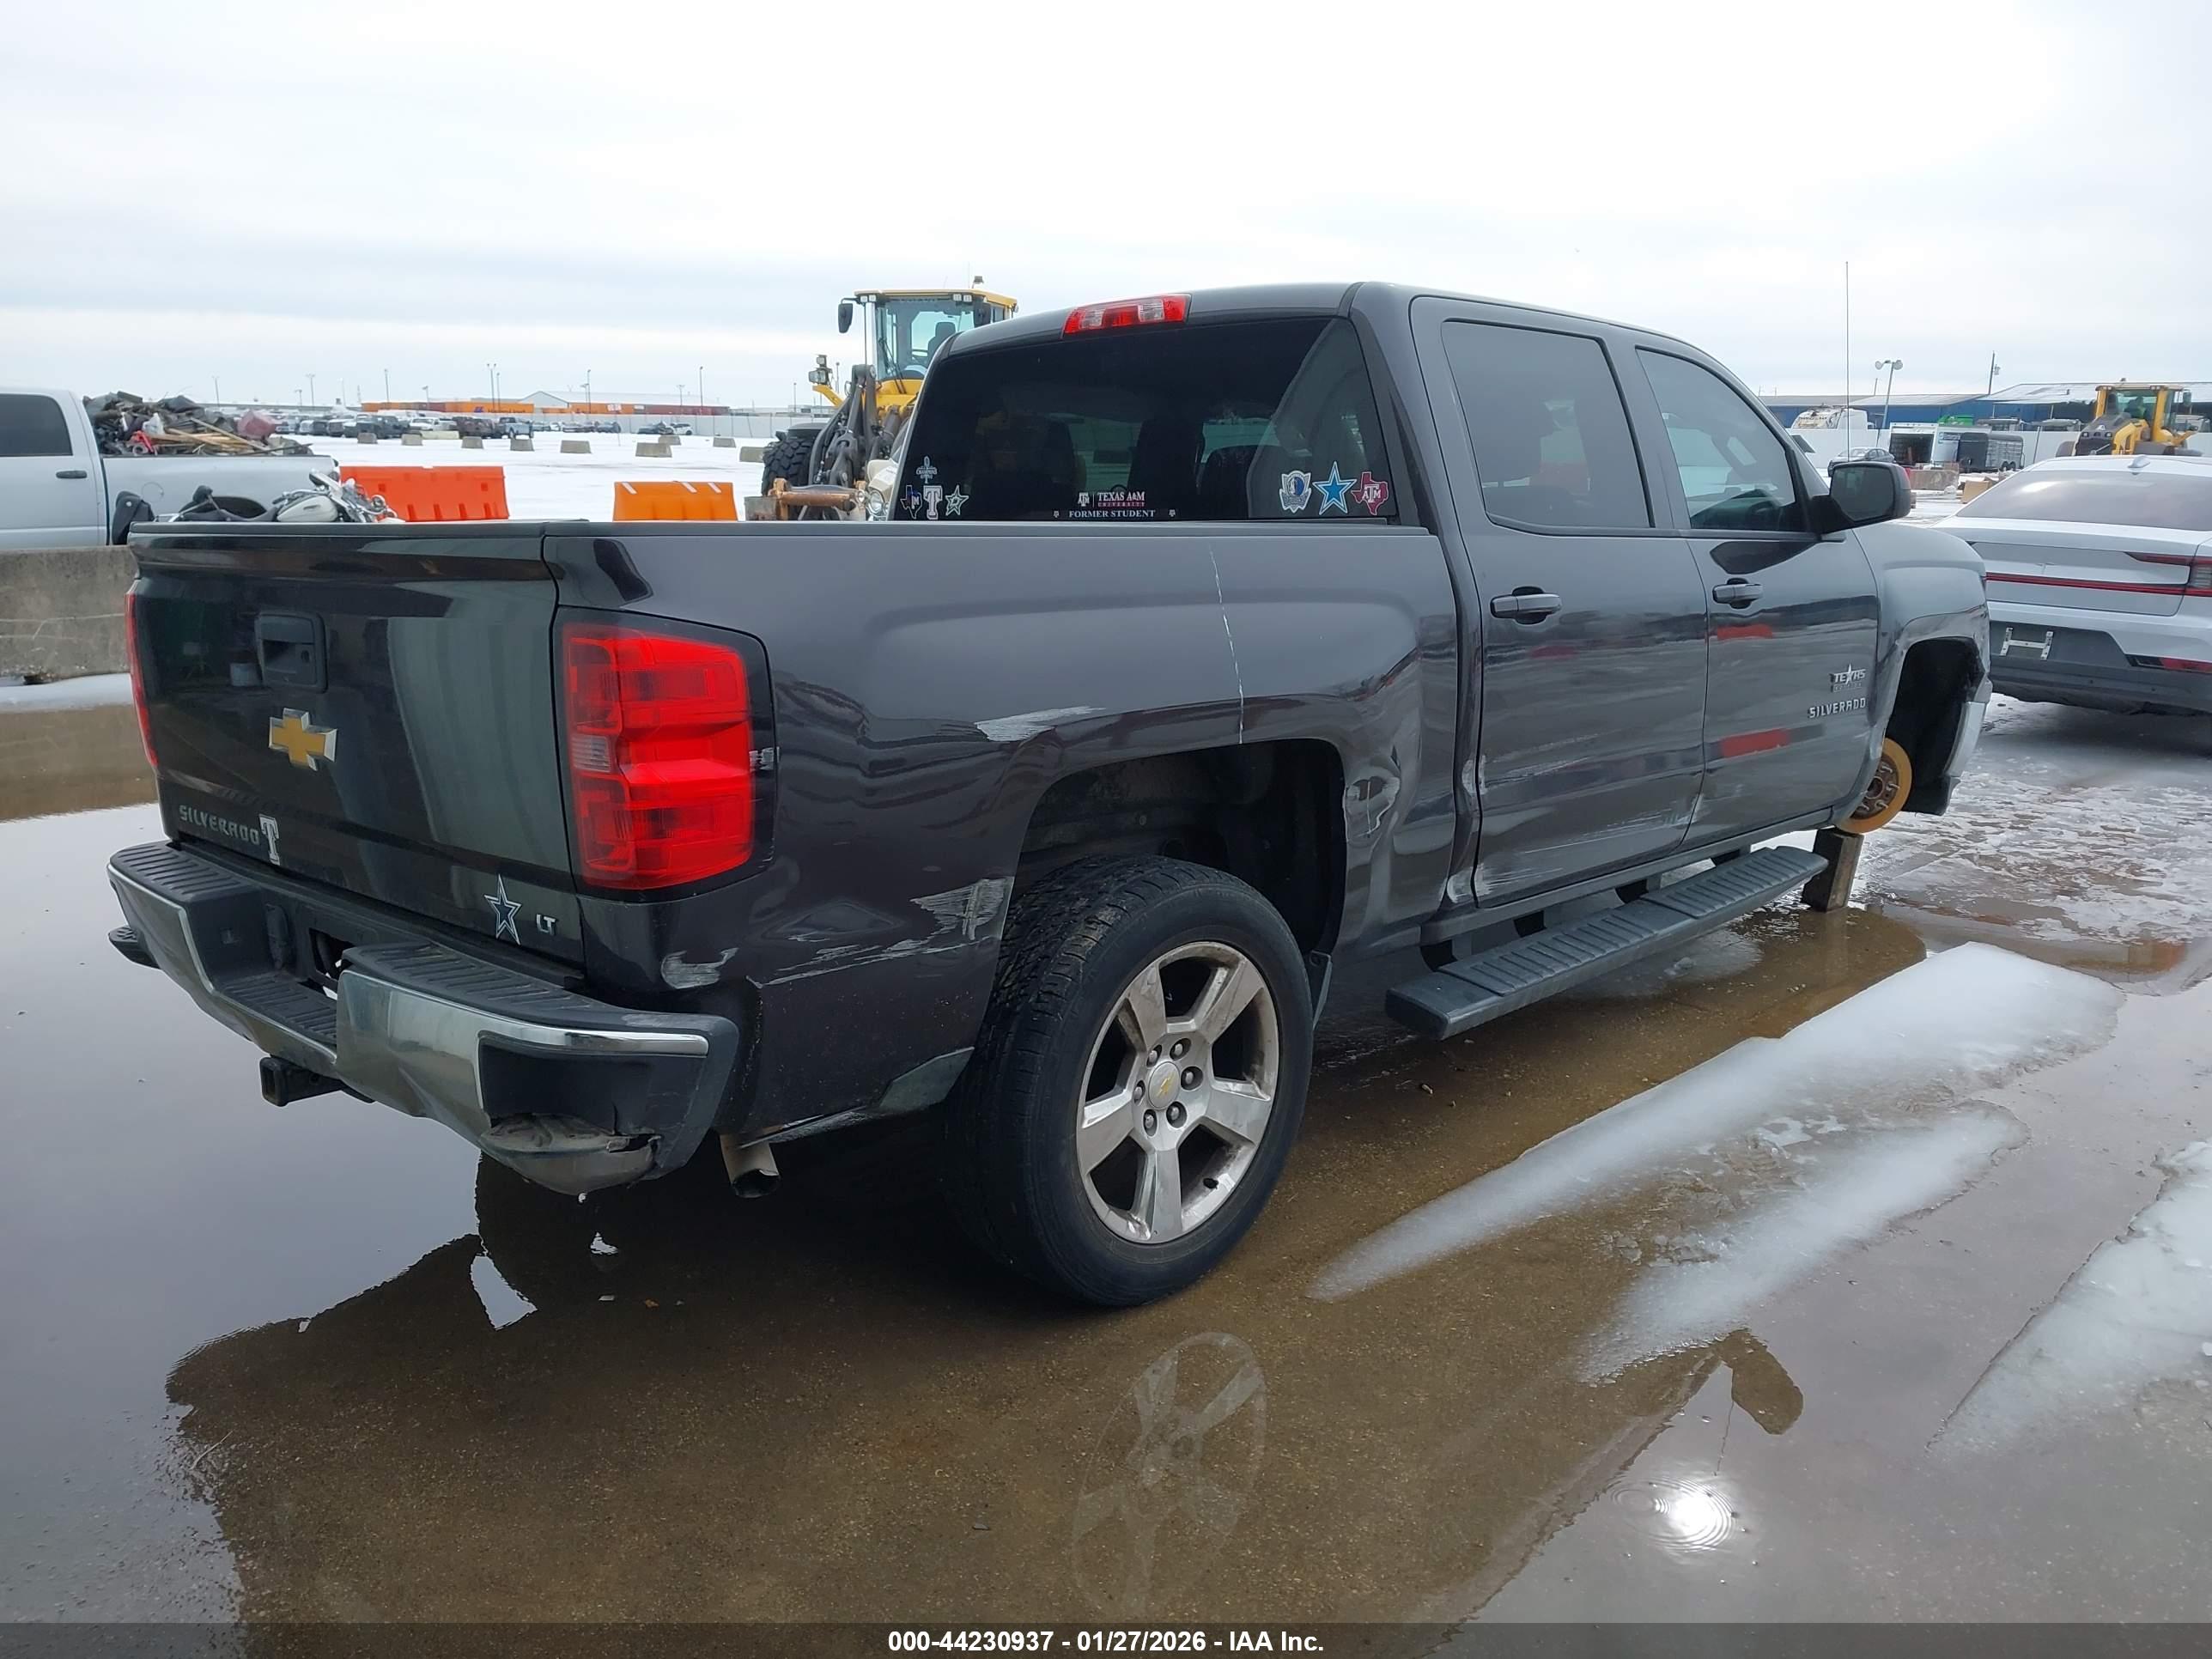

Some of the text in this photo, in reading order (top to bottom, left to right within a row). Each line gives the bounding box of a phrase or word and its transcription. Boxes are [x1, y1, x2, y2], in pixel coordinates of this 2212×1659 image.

[1097, 491, 1146, 501] TEXAS A&M
[1833, 664, 1866, 684] TEXAS
[1808, 697, 1866, 719] SILVERADO
[179, 805, 259, 845] SILVERADO
[536, 914, 556, 936] LT
